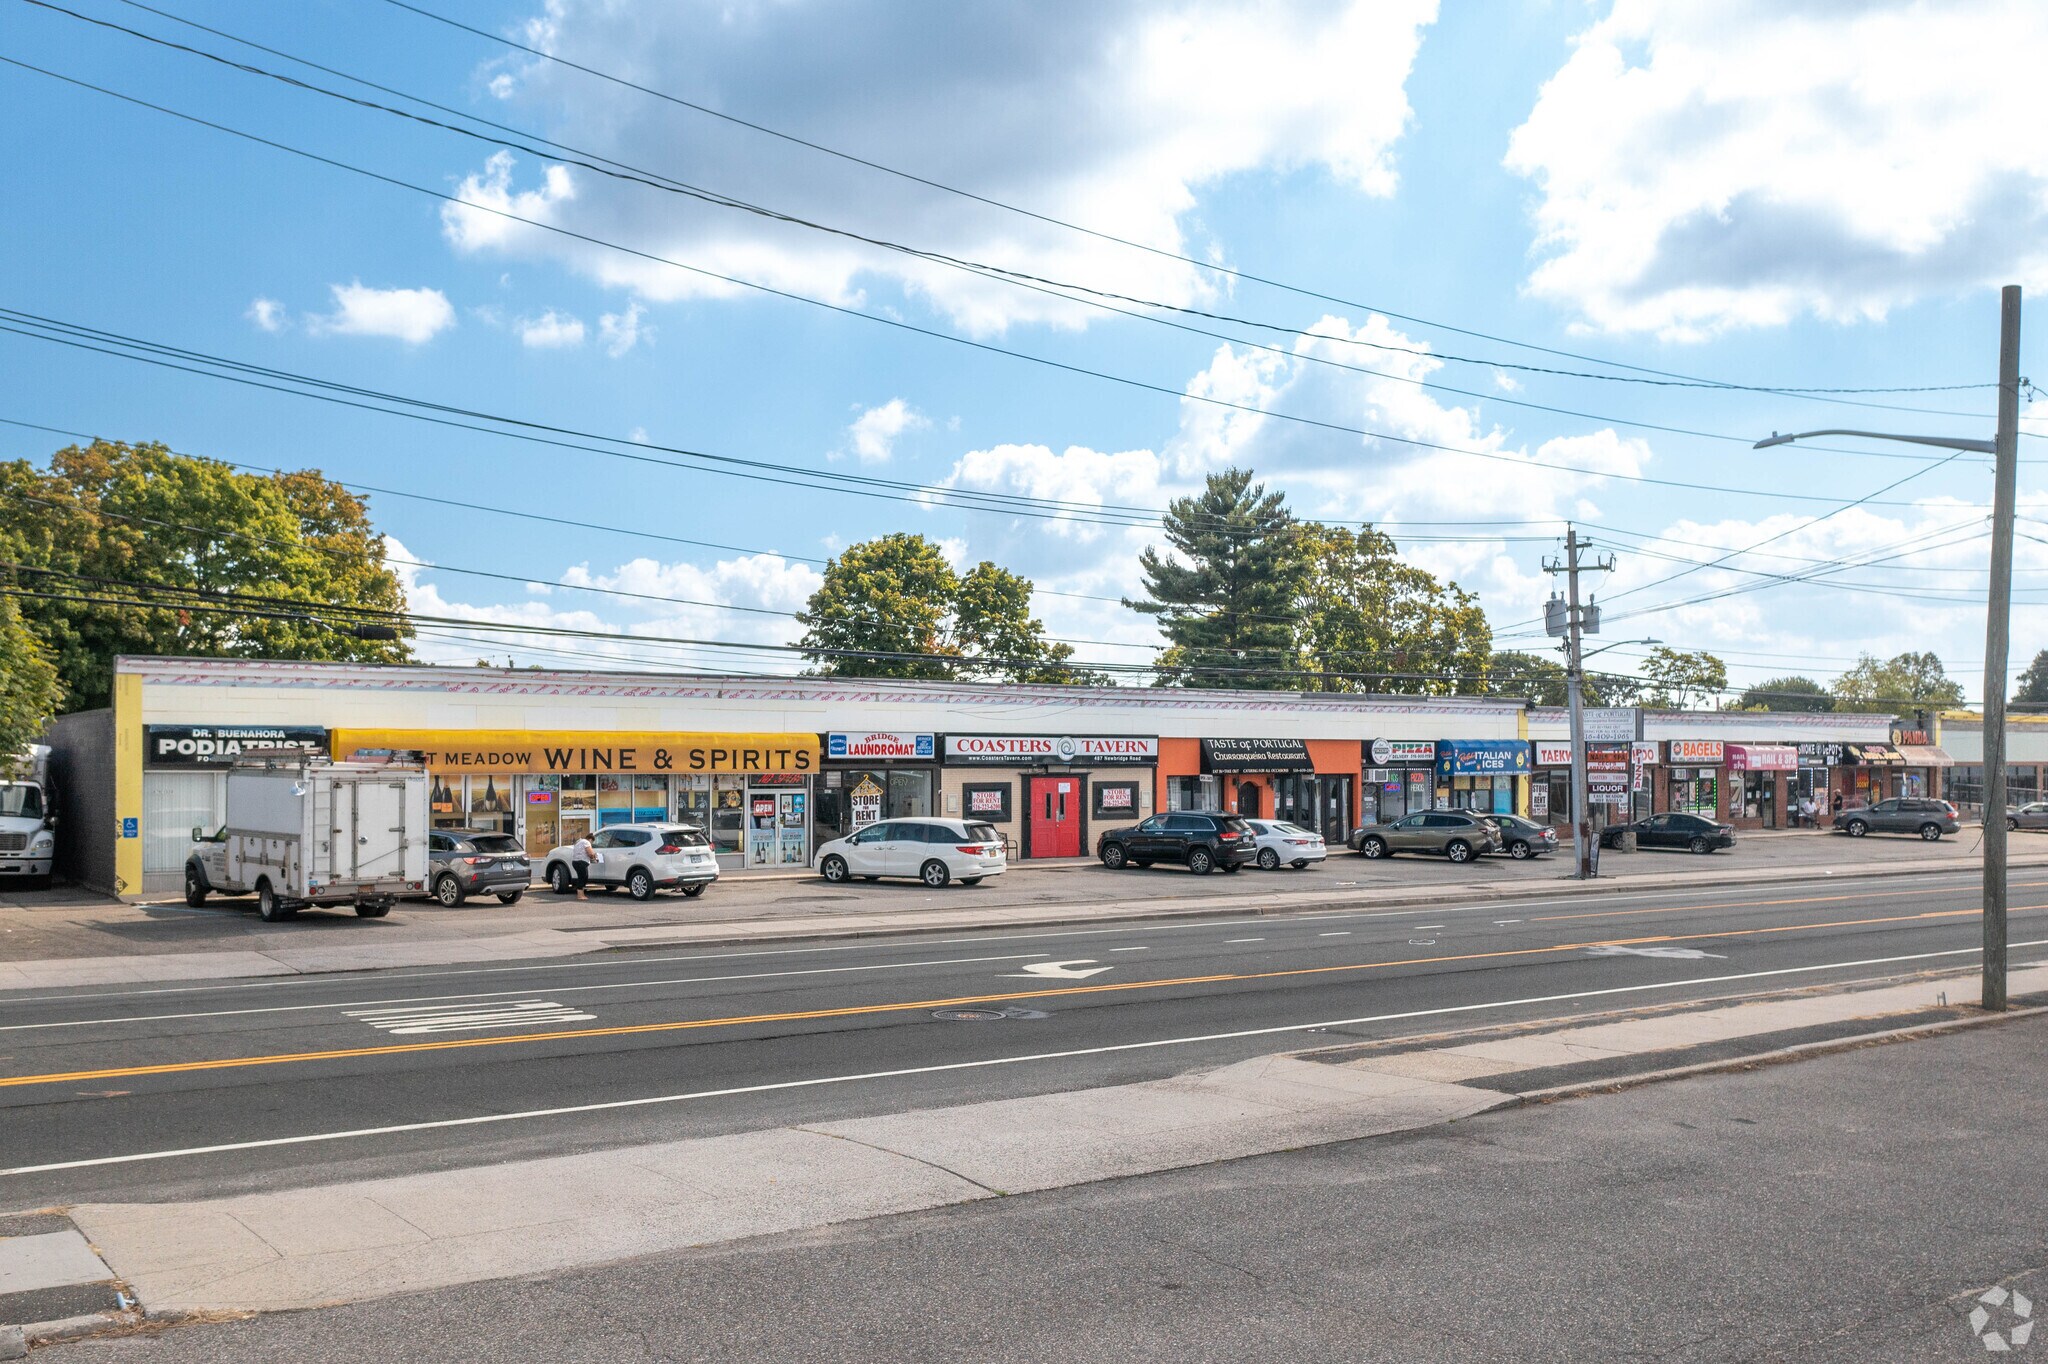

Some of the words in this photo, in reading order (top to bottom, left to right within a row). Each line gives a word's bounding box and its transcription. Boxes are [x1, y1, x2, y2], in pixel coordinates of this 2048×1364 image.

[192, 729, 212, 738] DR.
[217, 729, 286, 739] BUENAHORA
[865, 733, 899, 744] BRIDGE
[1902, 730, 1928, 745] PANDA
[848, 743, 915, 756] LAUNDROMAT
[957, 739, 1051, 753] COASTERS
[1082, 740, 1149, 753] TAVERN
[1208, 739, 1237, 749] TASTE
[1239, 740, 1252, 750] of
[1253, 739, 1303, 749] PORTUGAL
[1391, 743, 1433, 753] PIZZA
[1683, 742, 1722, 756] BAGELS
[445, 752, 532, 765] MEADOW
[543, 748, 636, 770] WINE
[653, 748, 672, 770] &
[689, 748, 810, 770] SPIRITS
[1267, 751, 1307, 760] Restaurant
[1475, 751, 1512, 760] ITALIAN
[1761, 754, 1777, 765] NAIL
[1778, 754, 1783, 764] &
[1784, 754, 1797, 765] SPA
[1482, 760, 1504, 768] ICES
[1410, 772, 1425, 783] PIZZA
[1532, 784, 1548, 792] STORE
[530, 793, 550, 802] OPEN
[852, 795, 880, 806] STORE
[755, 803, 773, 813] OPEN
[855, 810, 877, 821] RENT
